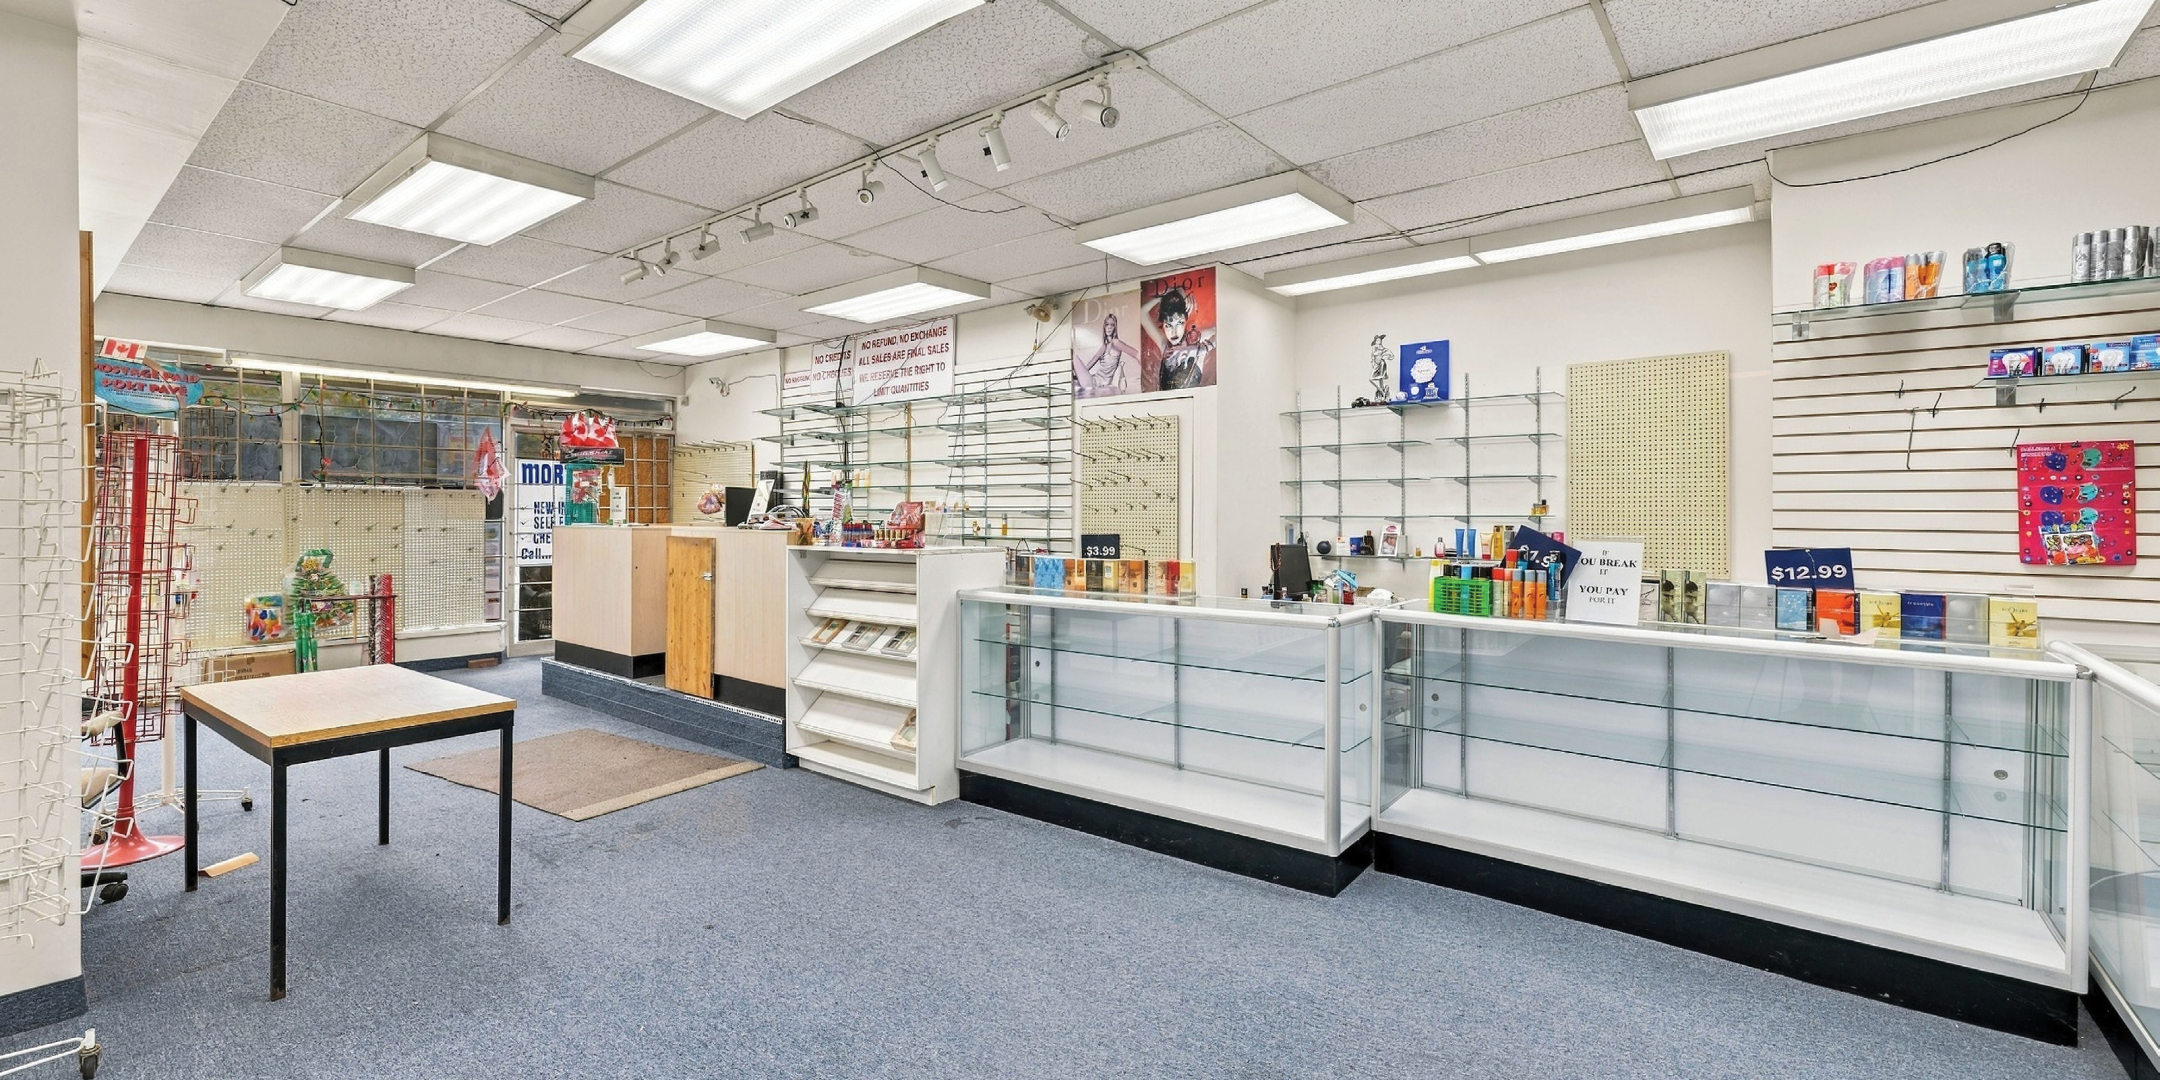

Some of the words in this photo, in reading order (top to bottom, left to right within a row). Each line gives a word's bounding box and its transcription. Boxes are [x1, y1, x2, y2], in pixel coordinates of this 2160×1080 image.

[1155, 275, 1205, 296] Dior
[1083, 298, 1129, 324] Dior
[862, 341, 871, 350] NO
[872, 336, 898, 349] REFUND,
[900, 334, 909, 343] NO
[911, 326, 948, 342] EXCHANGE
[814, 355, 824, 365] NO
[825, 350, 851, 362] CREDTS
[859, 356, 870, 366] ALL
[871, 352, 891, 364] SALES
[892, 349, 906, 360] ARE
[907, 347, 926, 359] FINAL
[927, 342, 950, 355] SALES
[813, 371, 821, 381] NO
[870, 368, 899, 381] RESERVE
[900, 366, 913, 377] THE
[914, 363, 935, 375] RIGHT
[937, 361, 946, 372] TO
[102, 378, 147, 392] PORT
[873, 386, 890, 397] LIMIT
[891, 381, 929, 395] QUANTITIES
[521, 463, 566, 486] MOR
[533, 501, 555, 515] NEW
[533, 532, 551, 544] CRE
[1086, 546, 1116, 557] $3.99
[1580, 557, 1596, 566] OU
[1599, 558, 1638, 568] BREAK
[1771, 564, 1847, 581] $12.99
[1579, 584, 1603, 594] YOU
[1606, 586, 1629, 596] PAY
